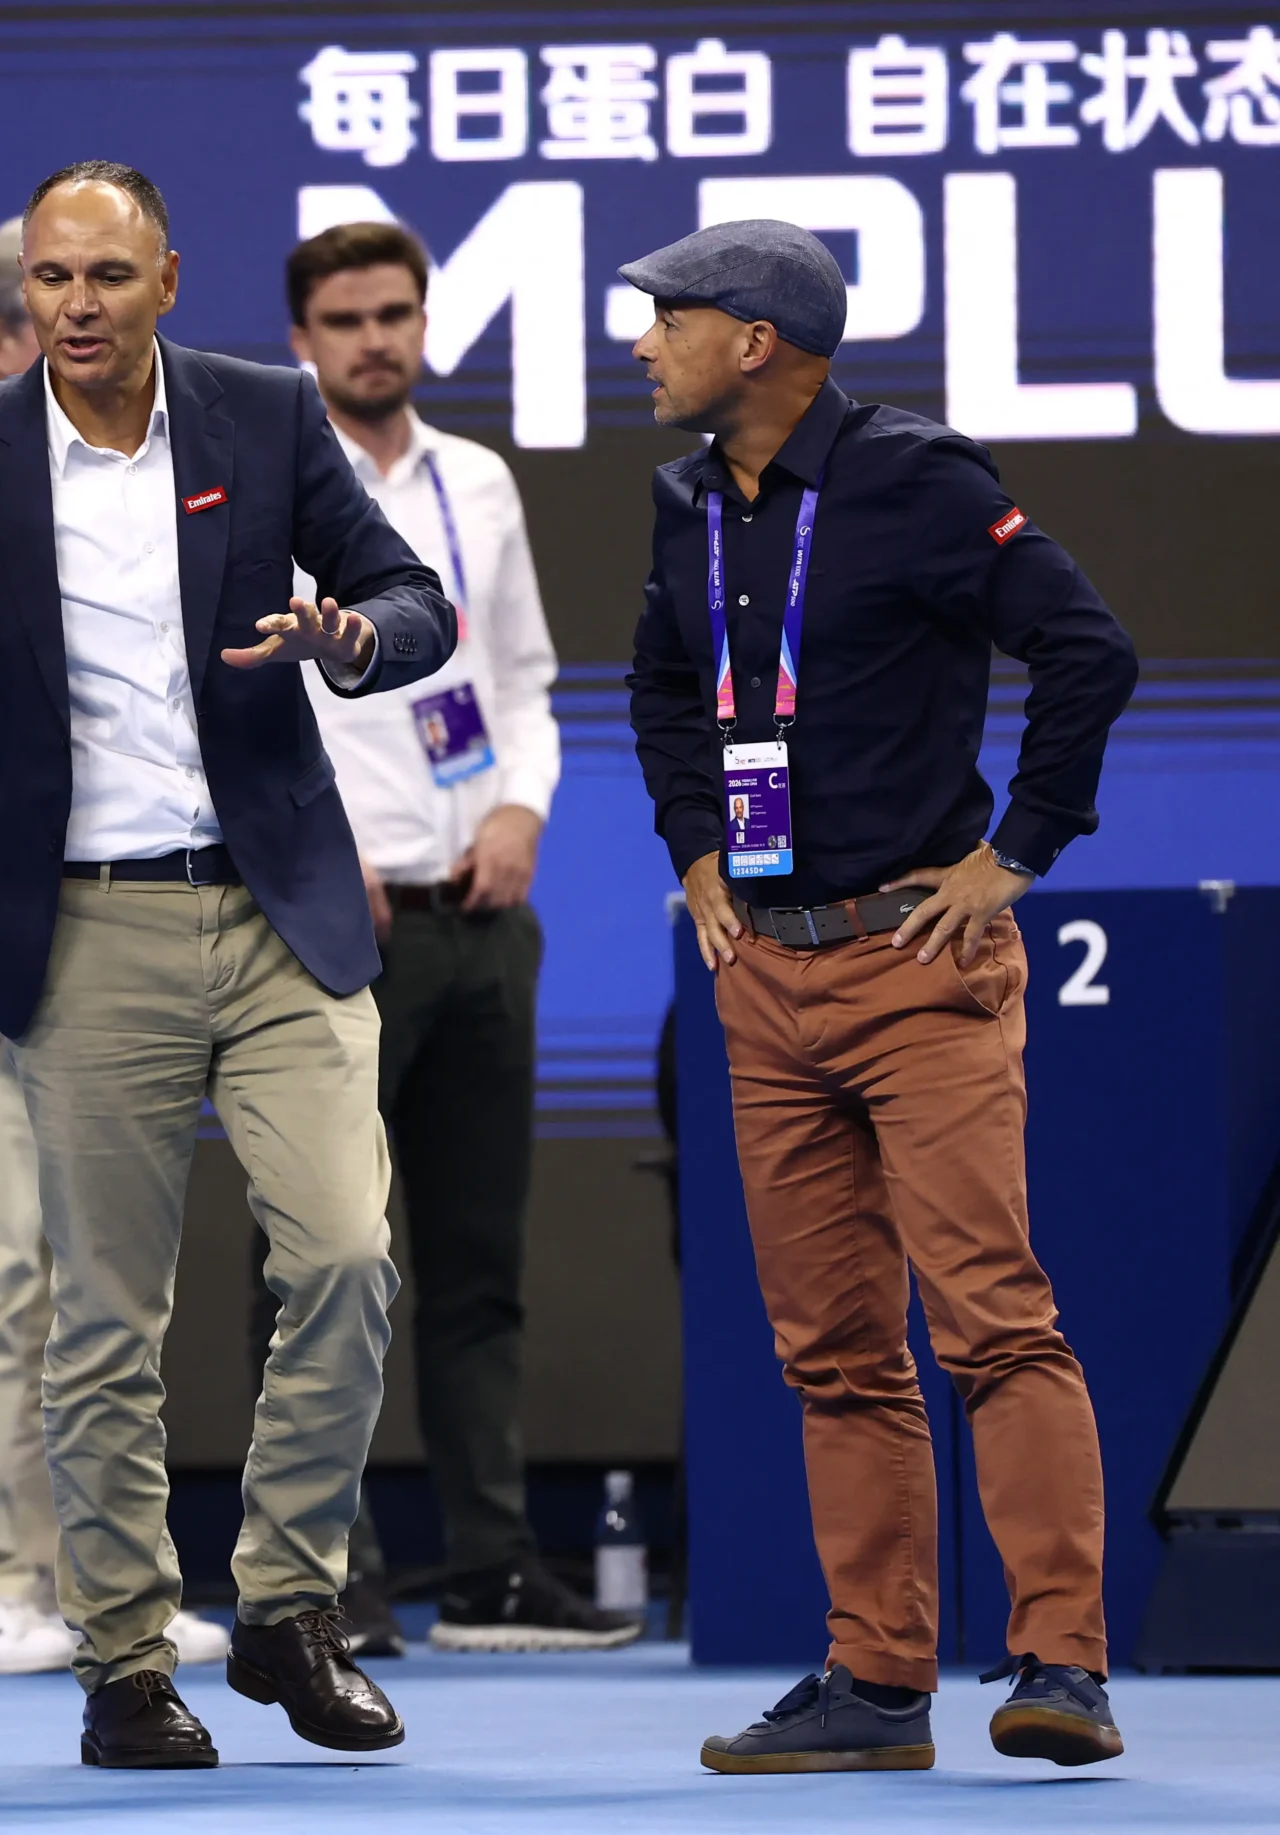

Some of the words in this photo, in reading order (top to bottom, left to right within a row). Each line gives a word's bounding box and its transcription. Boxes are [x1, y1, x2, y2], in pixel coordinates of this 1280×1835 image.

[299, 37, 772, 168] 每日蛋白
[845, 27, 1280, 157] 自在状态
[187, 492, 222, 509] Emirates
[768, 772, 778, 789] C
[1058, 919, 1109, 1006] 2
